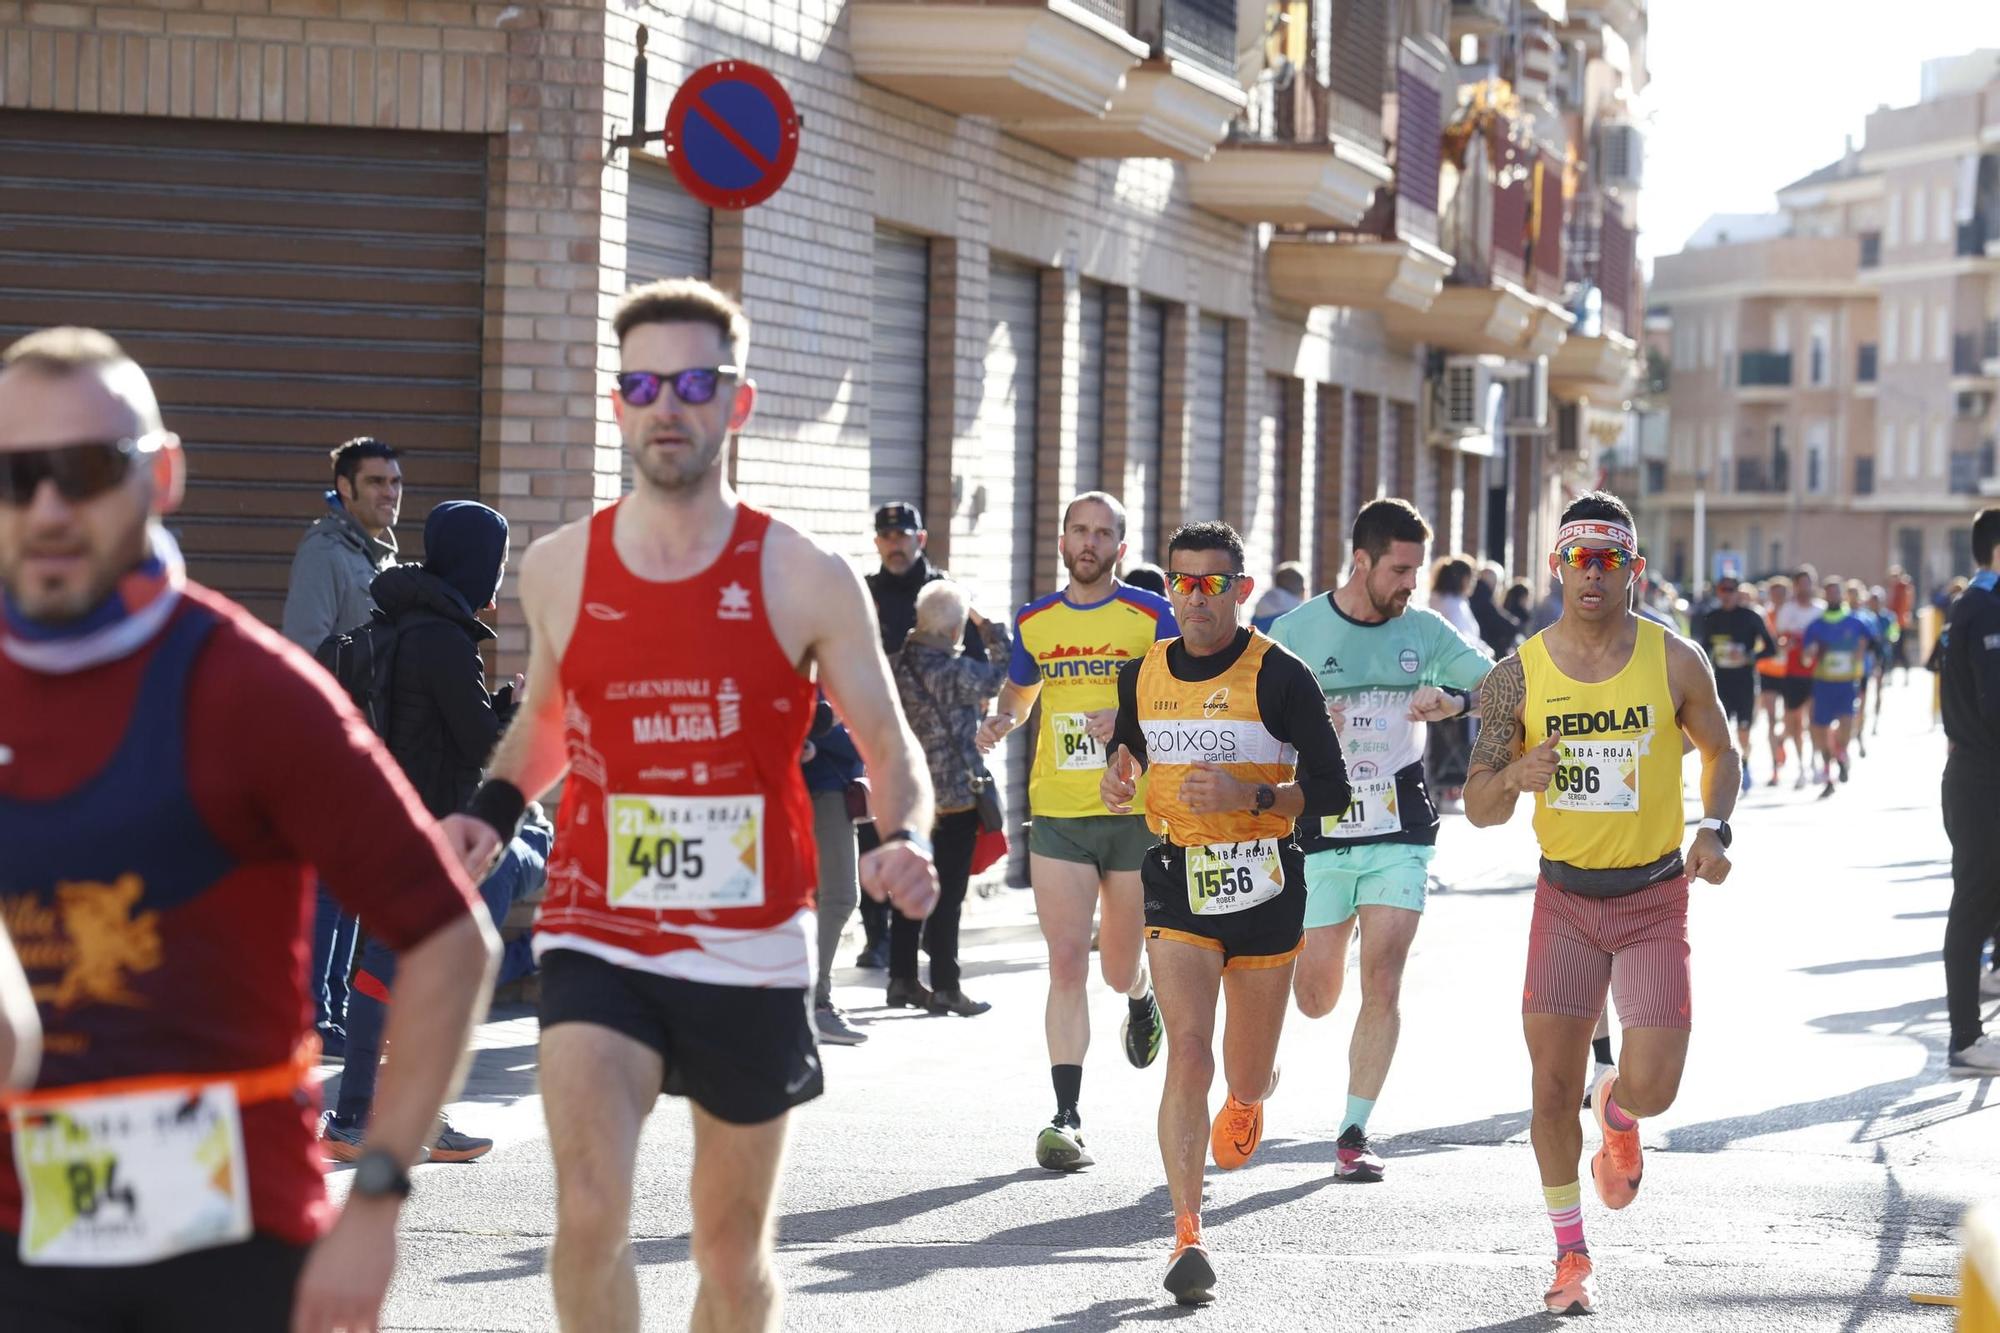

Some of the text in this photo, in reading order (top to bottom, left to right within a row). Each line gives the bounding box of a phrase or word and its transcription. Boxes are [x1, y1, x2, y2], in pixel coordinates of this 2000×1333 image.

[628, 679, 710, 698] GENERALI
[1089, 678, 1117, 686] VALEN
[632, 709, 718, 744] MÁLAGA
[1069, 718, 1089, 727] RIB
[1352, 717, 1372, 727] ITV
[1064, 733, 1096, 756] 841
[1564, 747, 1633, 759] RIBA-ROJA
[1203, 751, 1237, 763] carlet
[1555, 764, 1600, 794] 696
[1567, 792, 1588, 802] SERGIO
[648, 805, 753, 824] RIBA-ROJA
[628, 835, 704, 880] 405
[1210, 845, 1274, 862] RIBA-ROJA
[1193, 866, 1254, 899] 1556
[1215, 895, 1236, 905] ROBER
[67, 1153, 136, 1219] 84
